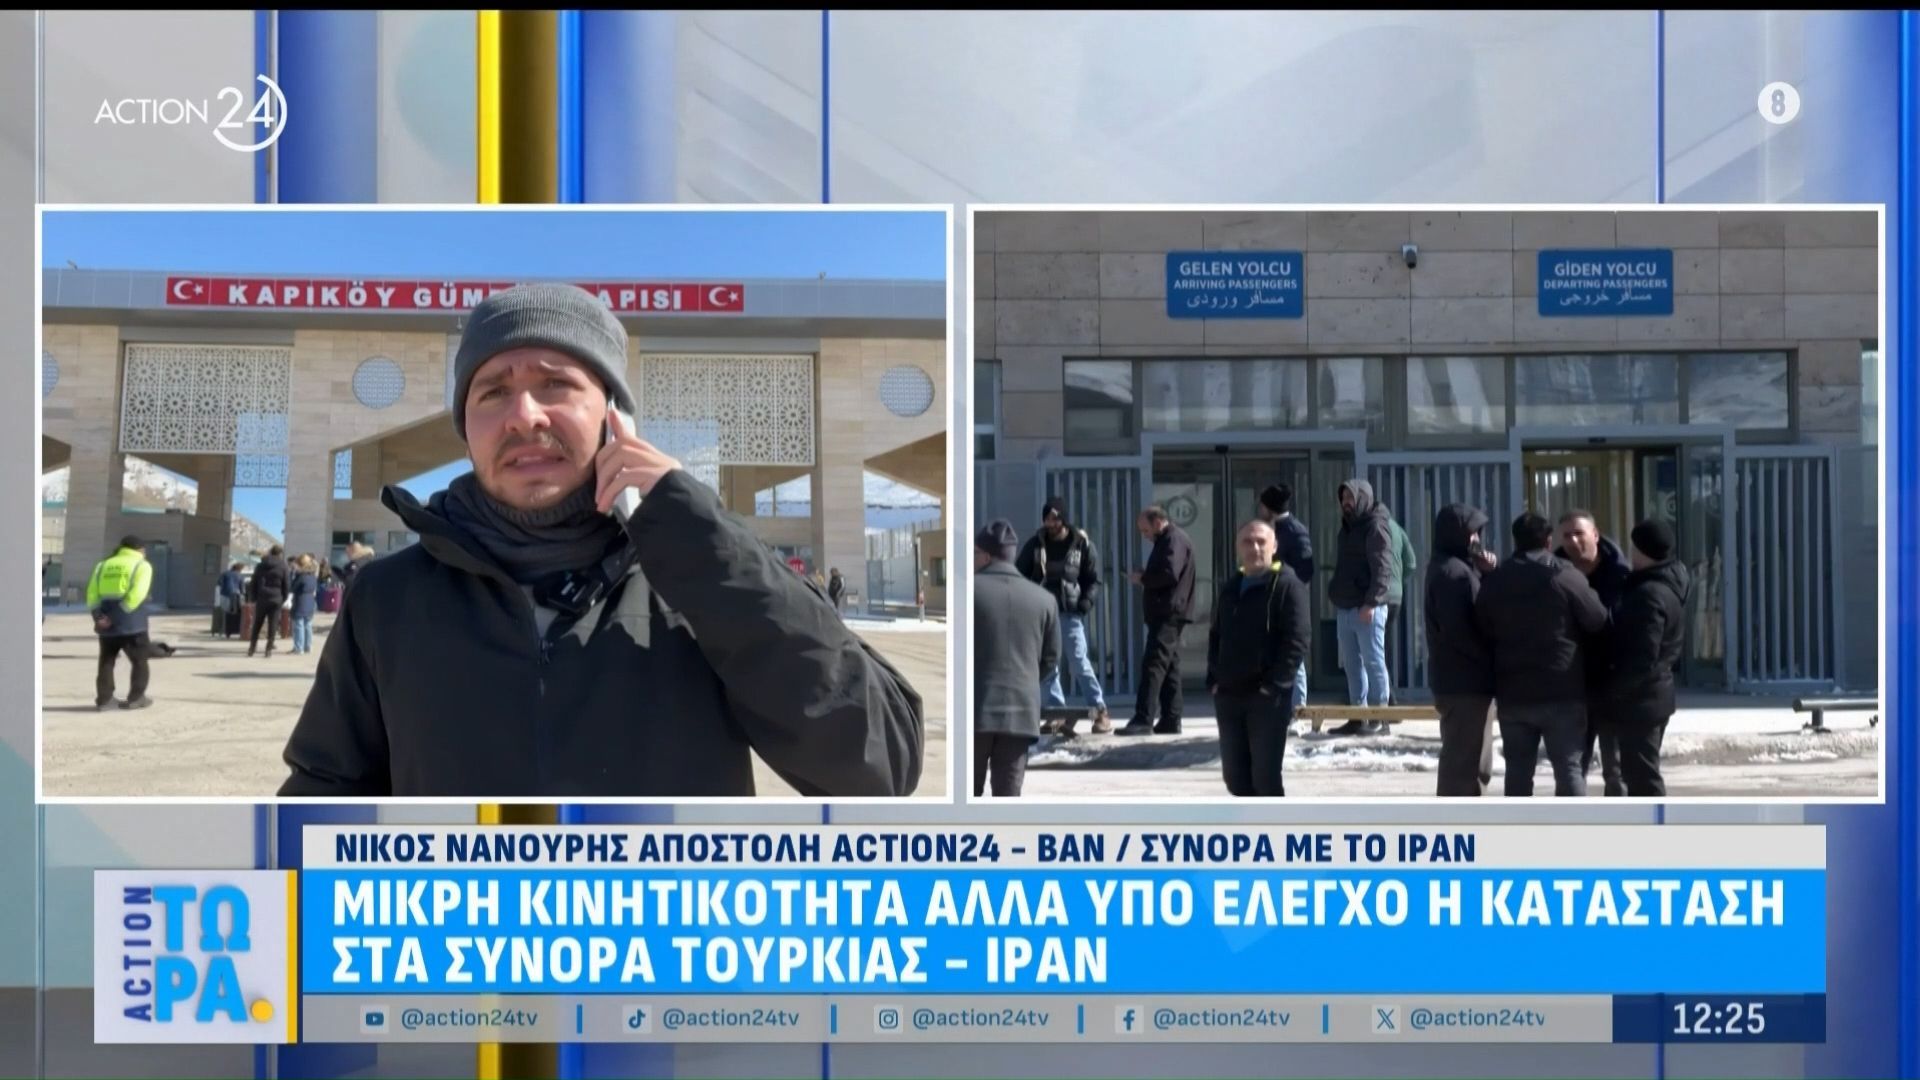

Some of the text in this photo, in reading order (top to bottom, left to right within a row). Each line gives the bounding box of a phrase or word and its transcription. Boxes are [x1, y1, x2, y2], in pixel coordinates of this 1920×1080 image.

[1179, 261, 1291, 276] GELEN YOLCU
[1554, 259, 1657, 276] GİDEN YOLCU
[1174, 279, 1298, 290] ARRIVING PASSENGERS
[1543, 279, 1668, 290] DEPARTING PASSENGERS
[228, 280, 396, 308] KAPIKÖY
[597, 289, 682, 310] APISI
